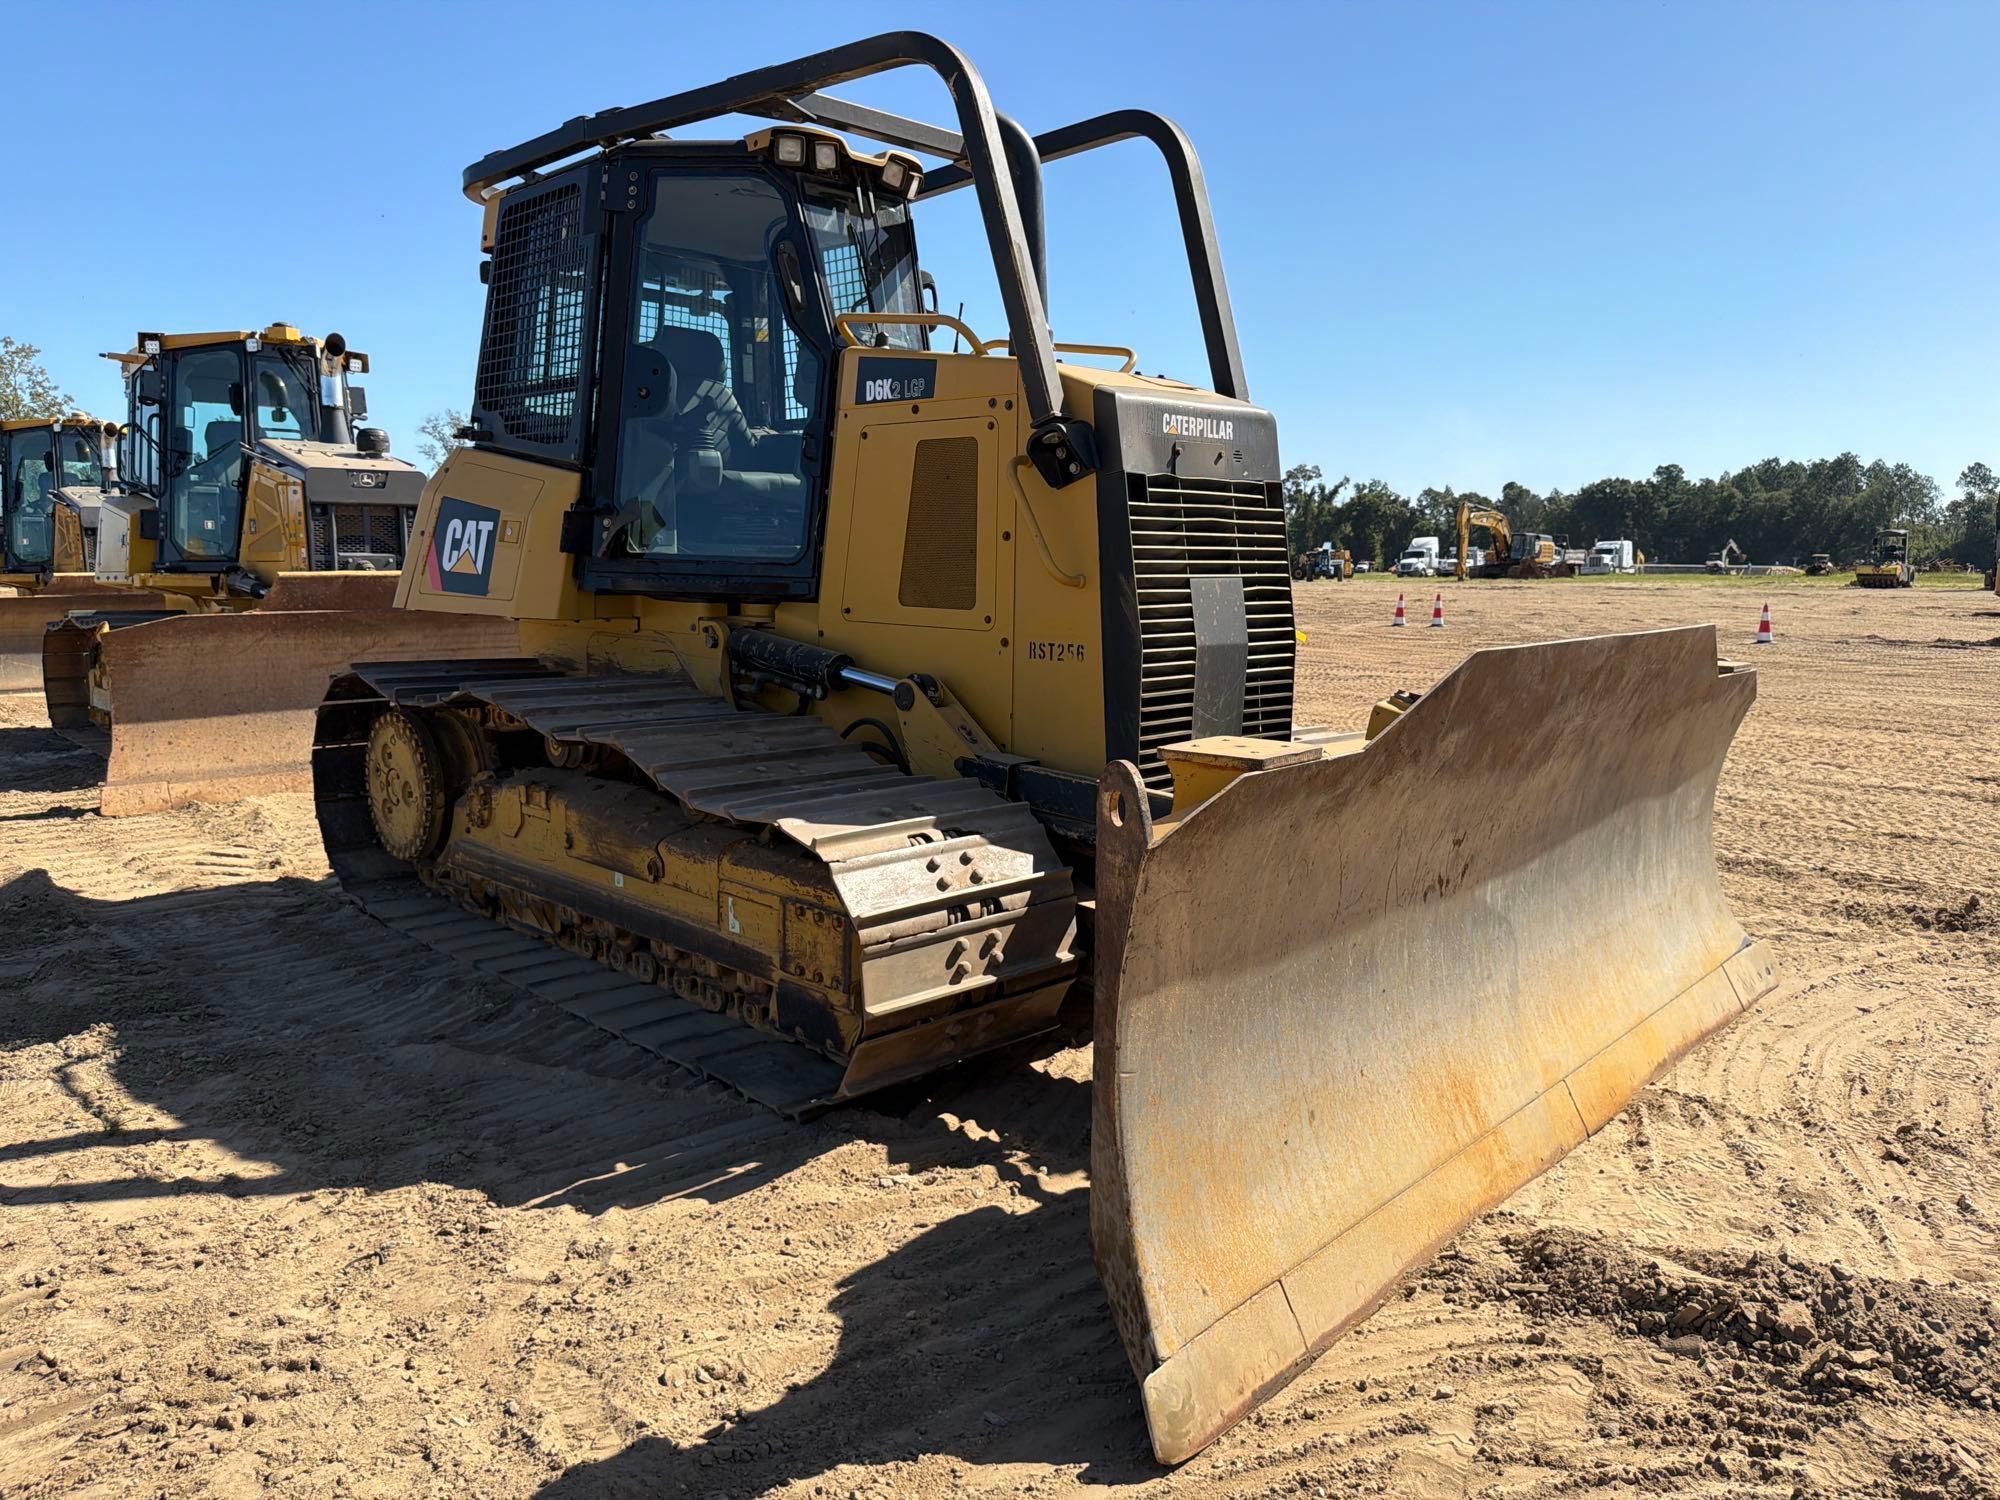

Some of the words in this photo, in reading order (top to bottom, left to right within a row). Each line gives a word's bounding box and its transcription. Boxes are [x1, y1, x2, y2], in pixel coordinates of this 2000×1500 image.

[866, 378, 900, 401] D6K2
[904, 378, 925, 398] LGP
[1162, 413, 1233, 440] CATERPILLAR
[442, 518, 494, 575] CAT
[1029, 641, 1084, 663] RST256
